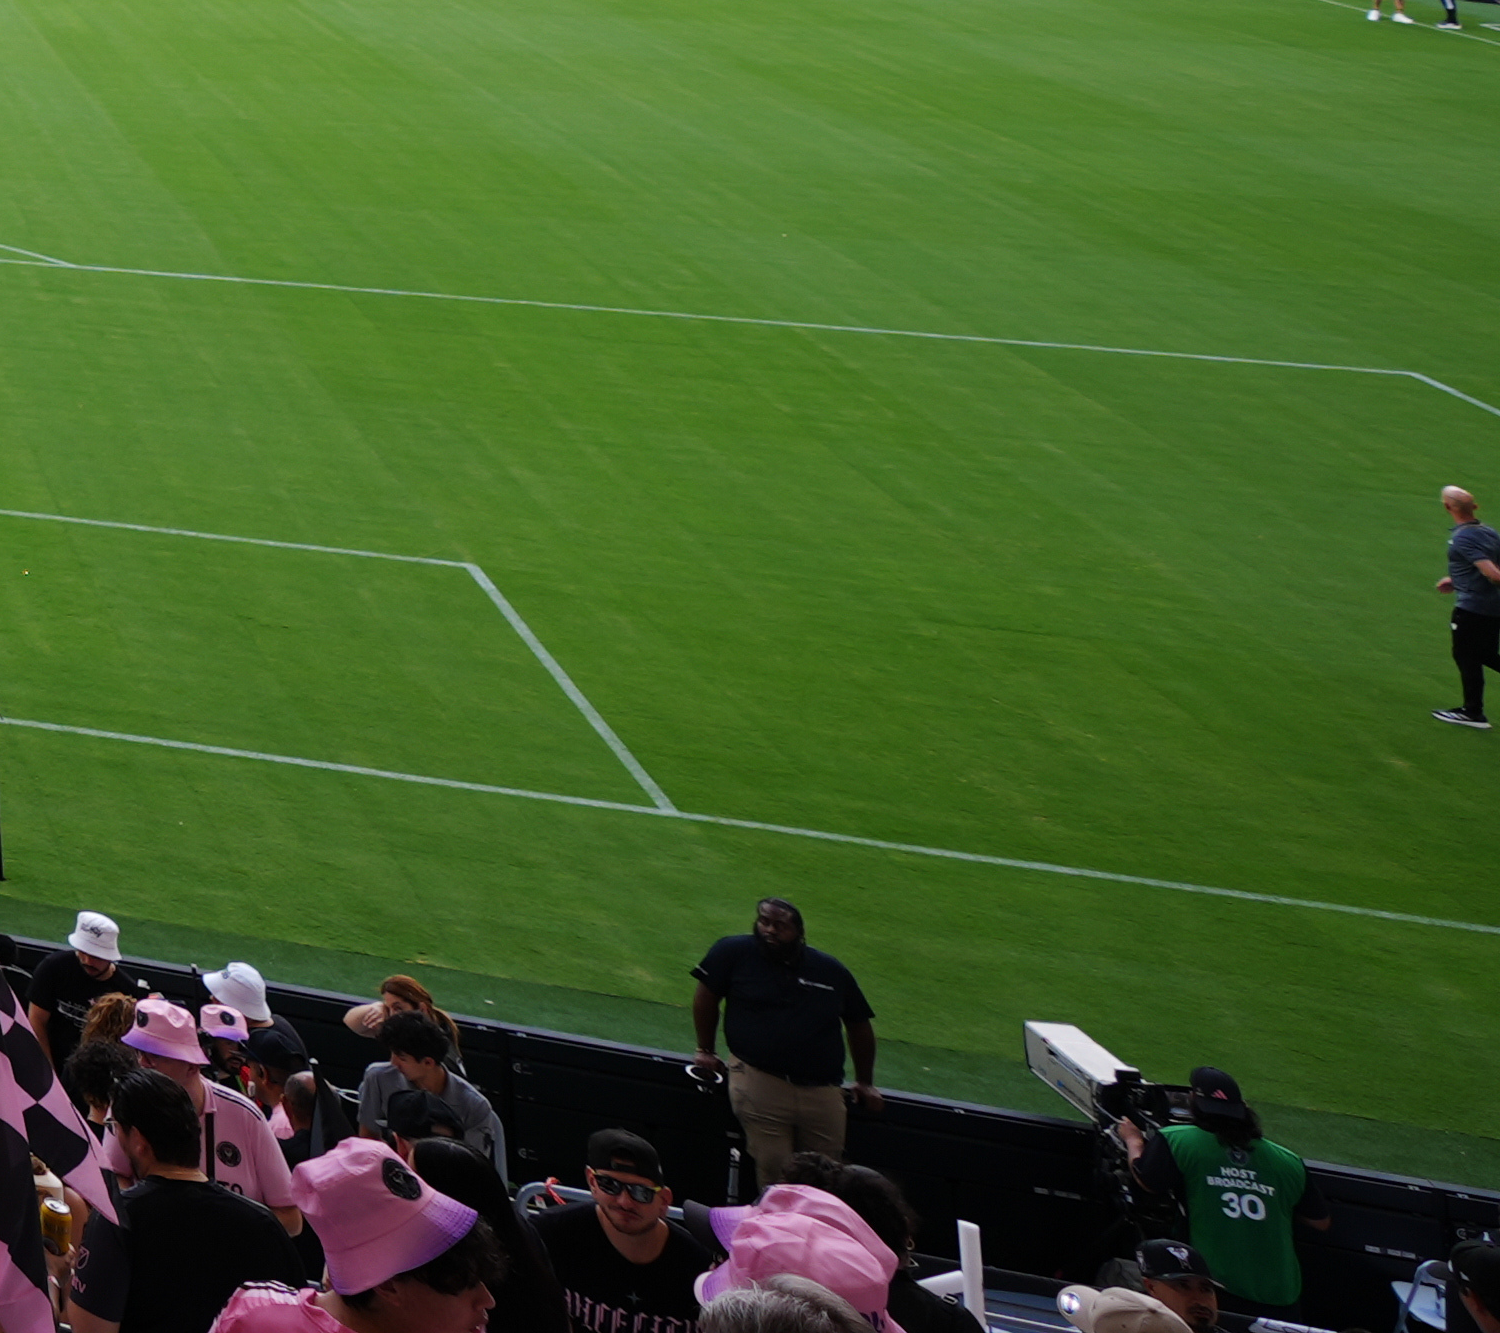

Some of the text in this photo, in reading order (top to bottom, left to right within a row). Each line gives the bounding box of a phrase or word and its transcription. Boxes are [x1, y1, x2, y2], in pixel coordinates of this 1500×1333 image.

[1219, 1165, 1258, 1181] HOST
[1206, 1175, 1276, 1198] BROADCAST
[1220, 1191, 1267, 1222] 30
